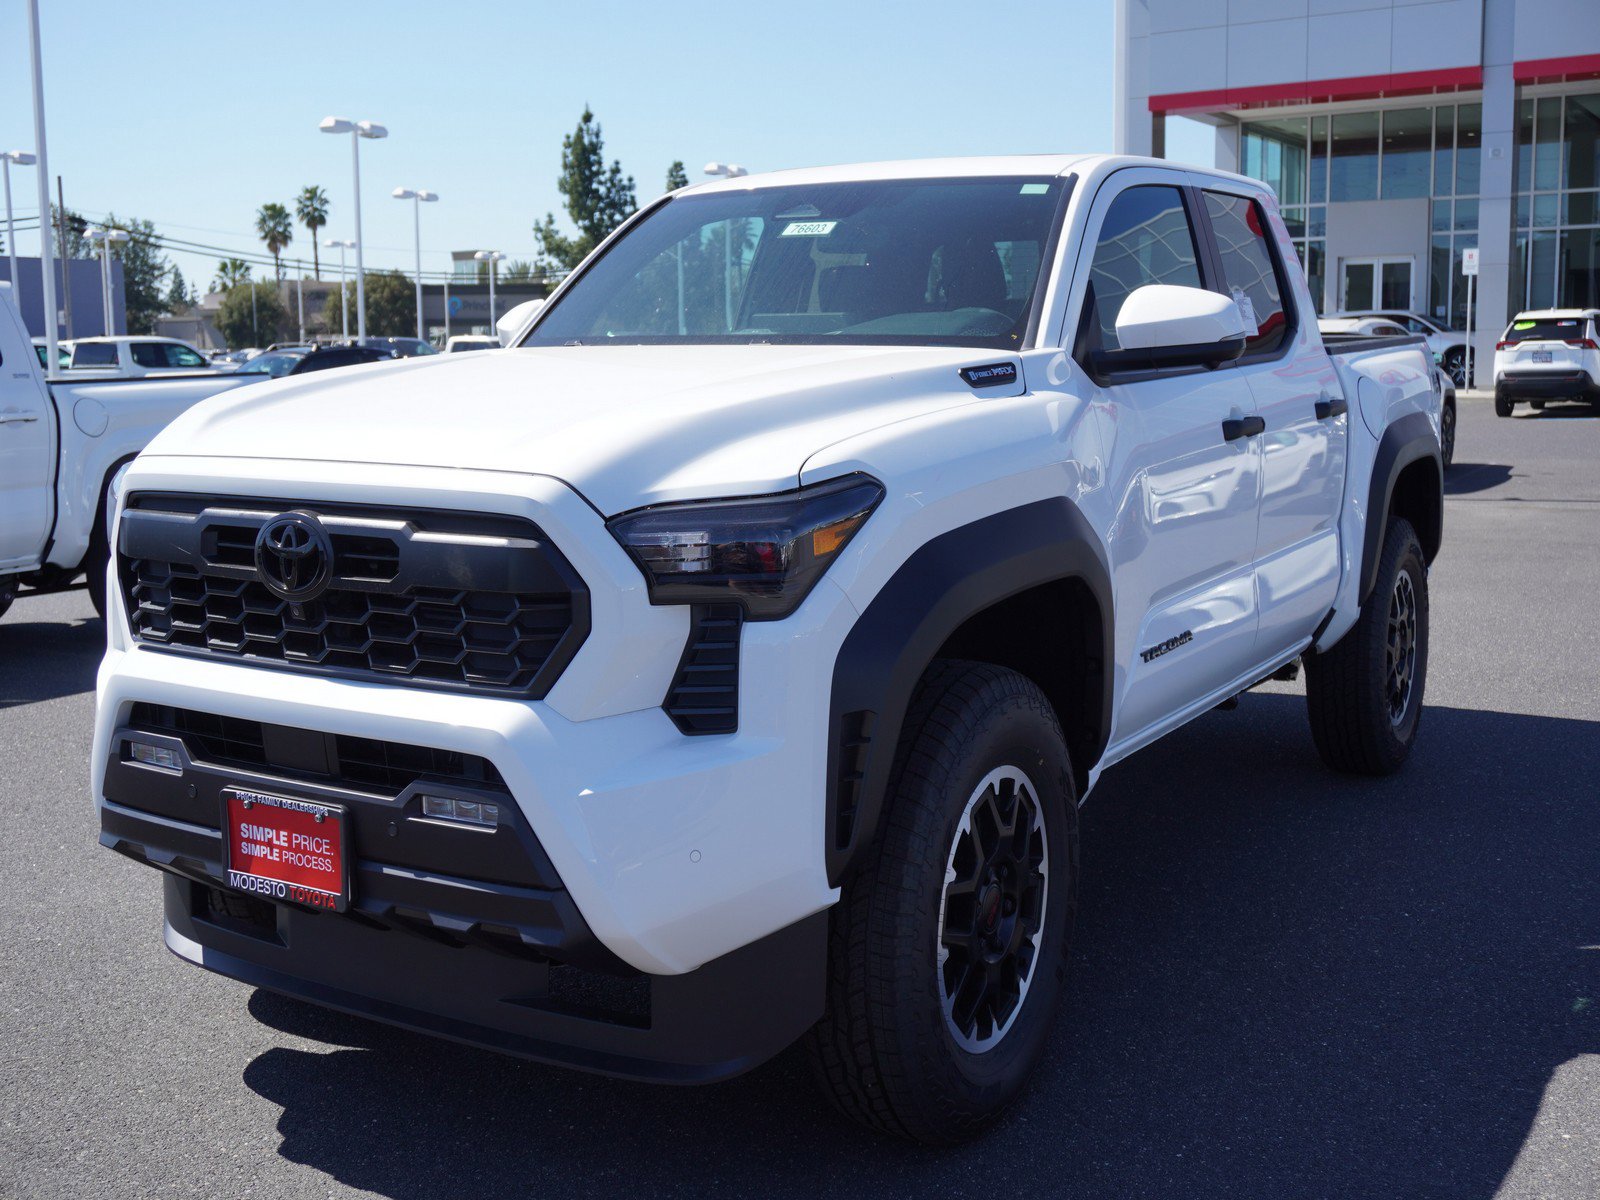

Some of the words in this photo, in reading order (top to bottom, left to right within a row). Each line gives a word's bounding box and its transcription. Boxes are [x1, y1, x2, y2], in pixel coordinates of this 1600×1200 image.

[790, 223, 827, 234] 76603
[1140, 630, 1193, 664] TACOMA
[236, 792, 257, 803] PRICE
[257, 795, 281, 808] FAMILY
[282, 800, 329, 816] DEALERSHIPS
[240, 822, 288, 847] SIMPLE
[292, 833, 334, 856] PRICE.
[241, 841, 280, 861] SIMPLE
[282, 850, 335, 873] PROCESS.
[230, 873, 285, 897] MODESTO
[289, 886, 336, 910] TOYOTA
